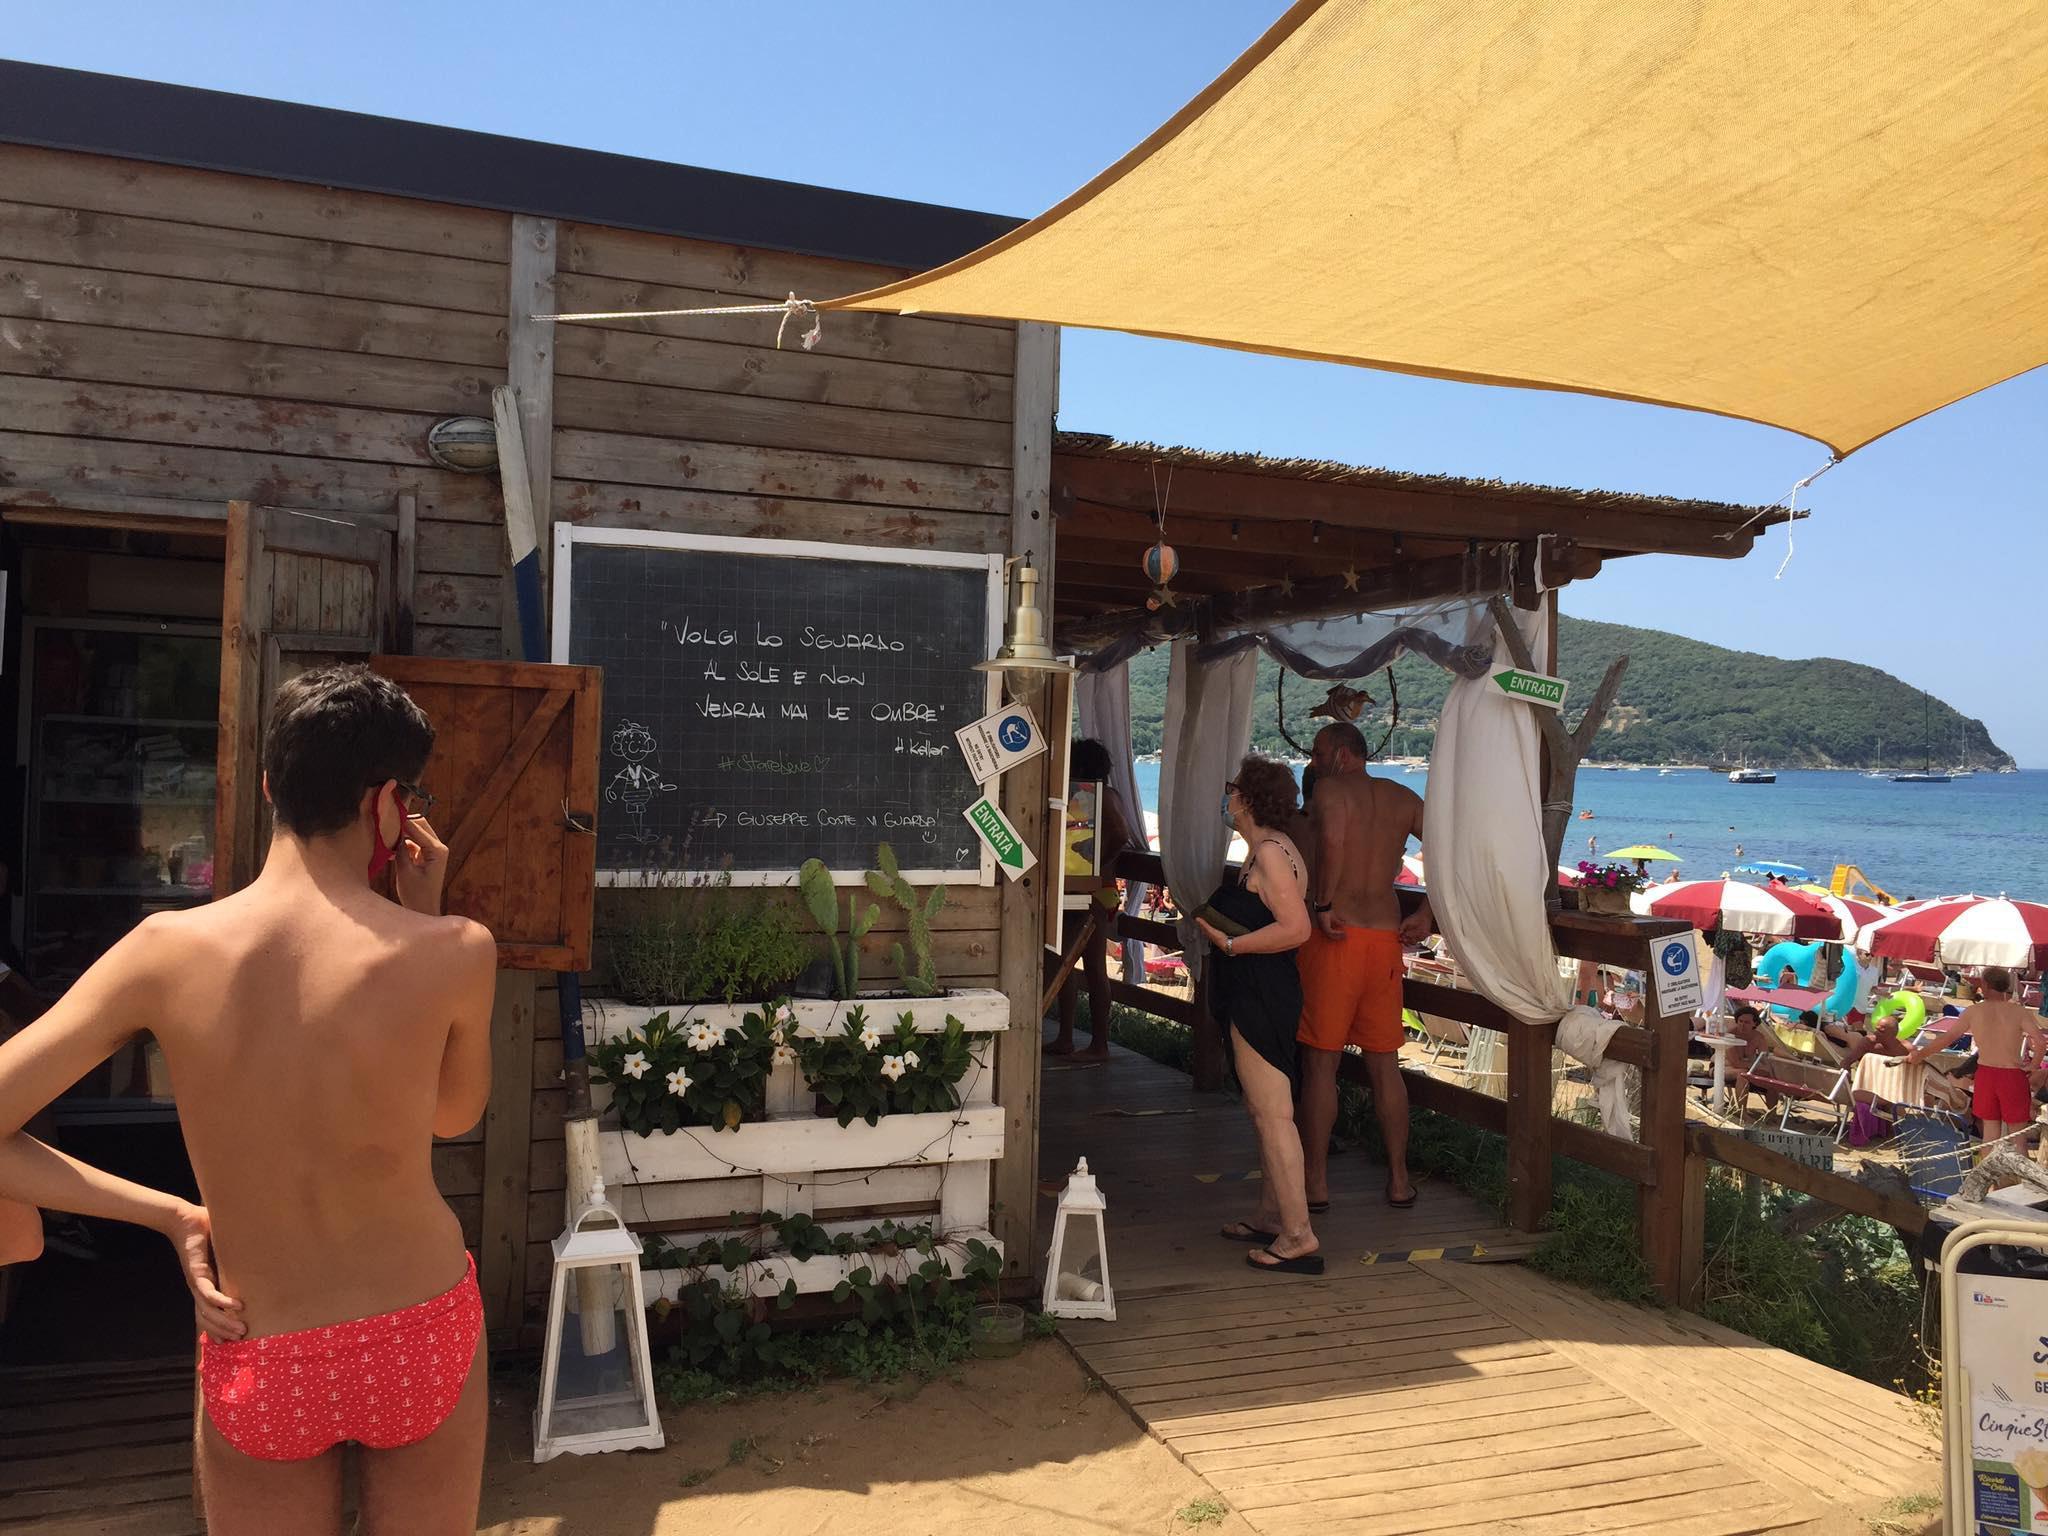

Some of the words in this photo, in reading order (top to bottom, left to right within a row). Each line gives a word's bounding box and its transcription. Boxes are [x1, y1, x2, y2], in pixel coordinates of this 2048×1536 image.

[757, 621, 783, 647] LO
[800, 626, 905, 652] SGUARDO
[704, 658, 726, 681] AL
[736, 661, 780, 684] SOLE
[793, 669, 808, 686] E
[819, 665, 866, 686] NON
[1510, 676, 1559, 699] ENTRATA
[696, 693, 766, 720] VEDRAI
[781, 703, 808, 720] MAI
[828, 697, 850, 721] LE
[737, 811, 809, 827] GIUSEPPE
[817, 808, 857, 827] CONTE
[974, 804, 1014, 856] ENTRATA
